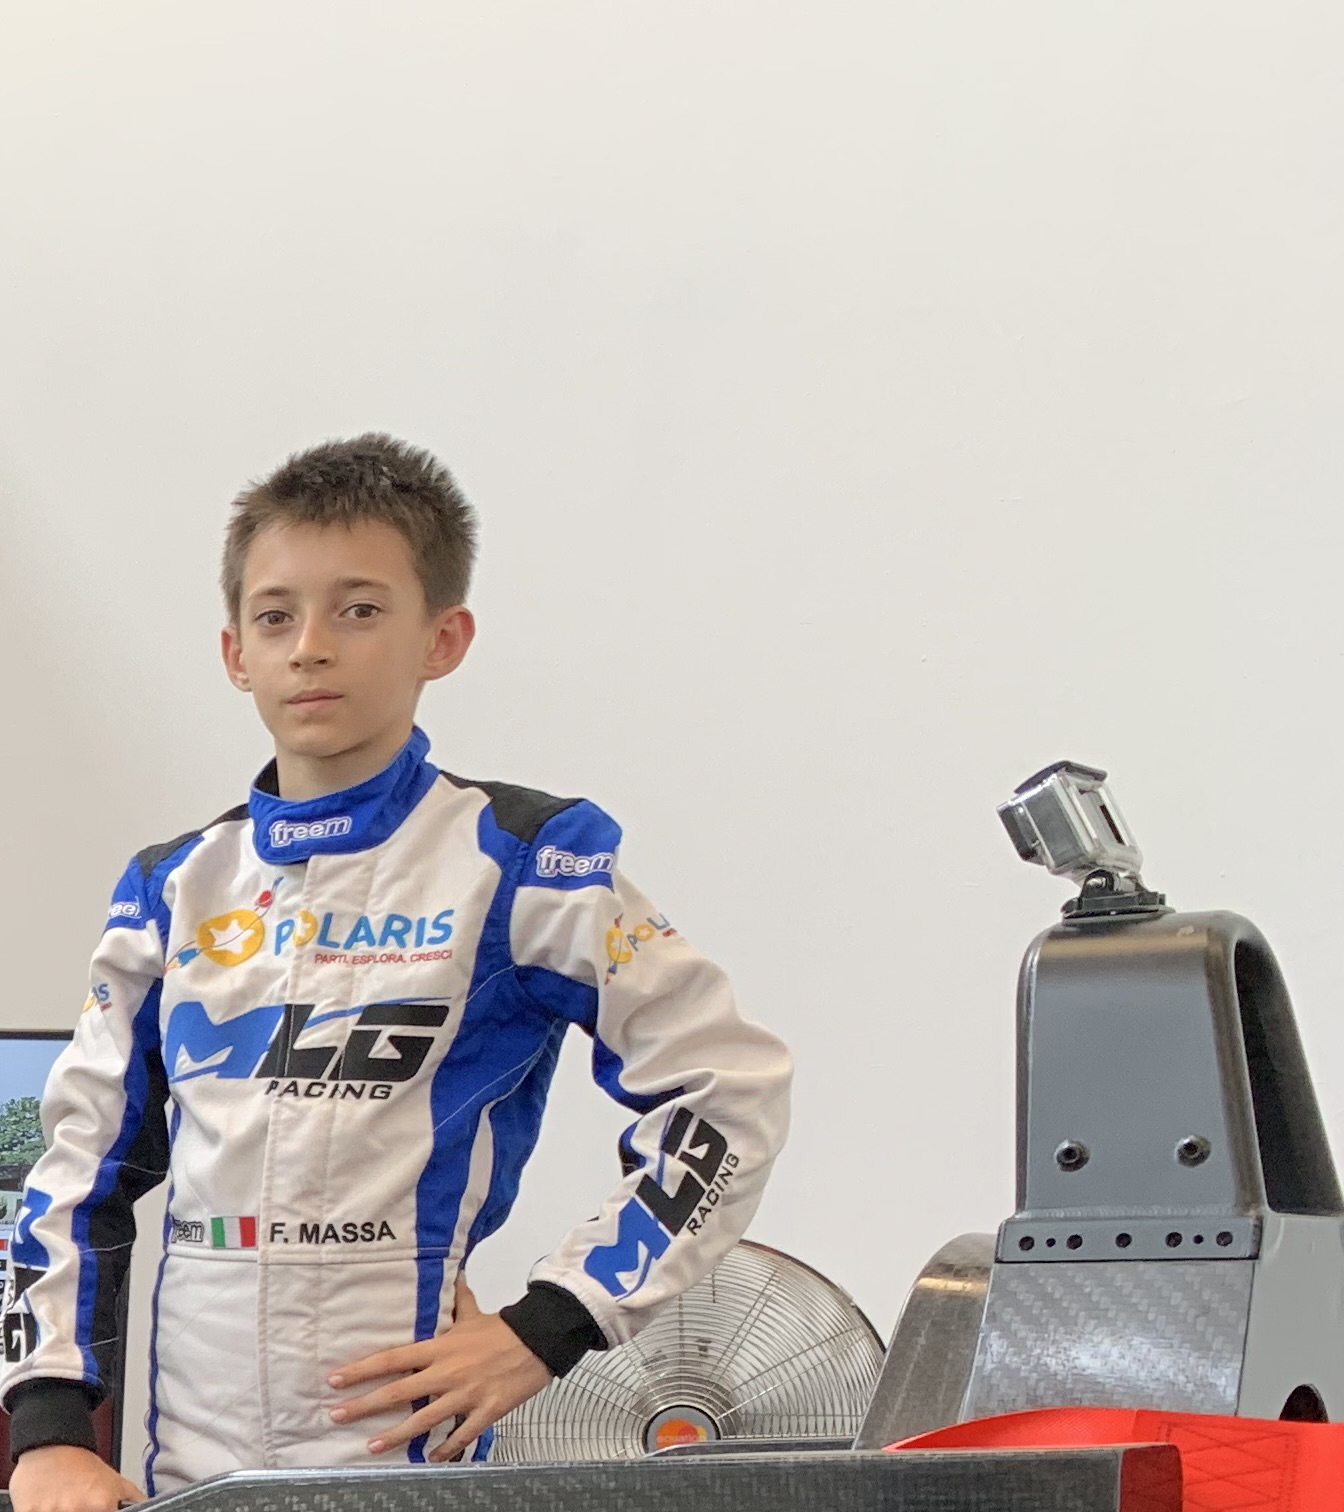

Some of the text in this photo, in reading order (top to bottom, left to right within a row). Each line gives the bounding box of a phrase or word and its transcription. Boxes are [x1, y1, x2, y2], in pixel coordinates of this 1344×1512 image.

[271, 817, 352, 848] freem
[537, 846, 615, 877] freem
[274, 909, 455, 956] POLARIS
[410, 950, 452, 962] CRESCI
[165, 999, 450, 1083] MLG
[686, 1152, 740, 1236] RACING
[269, 1221, 397, 1244] F. MASSA
